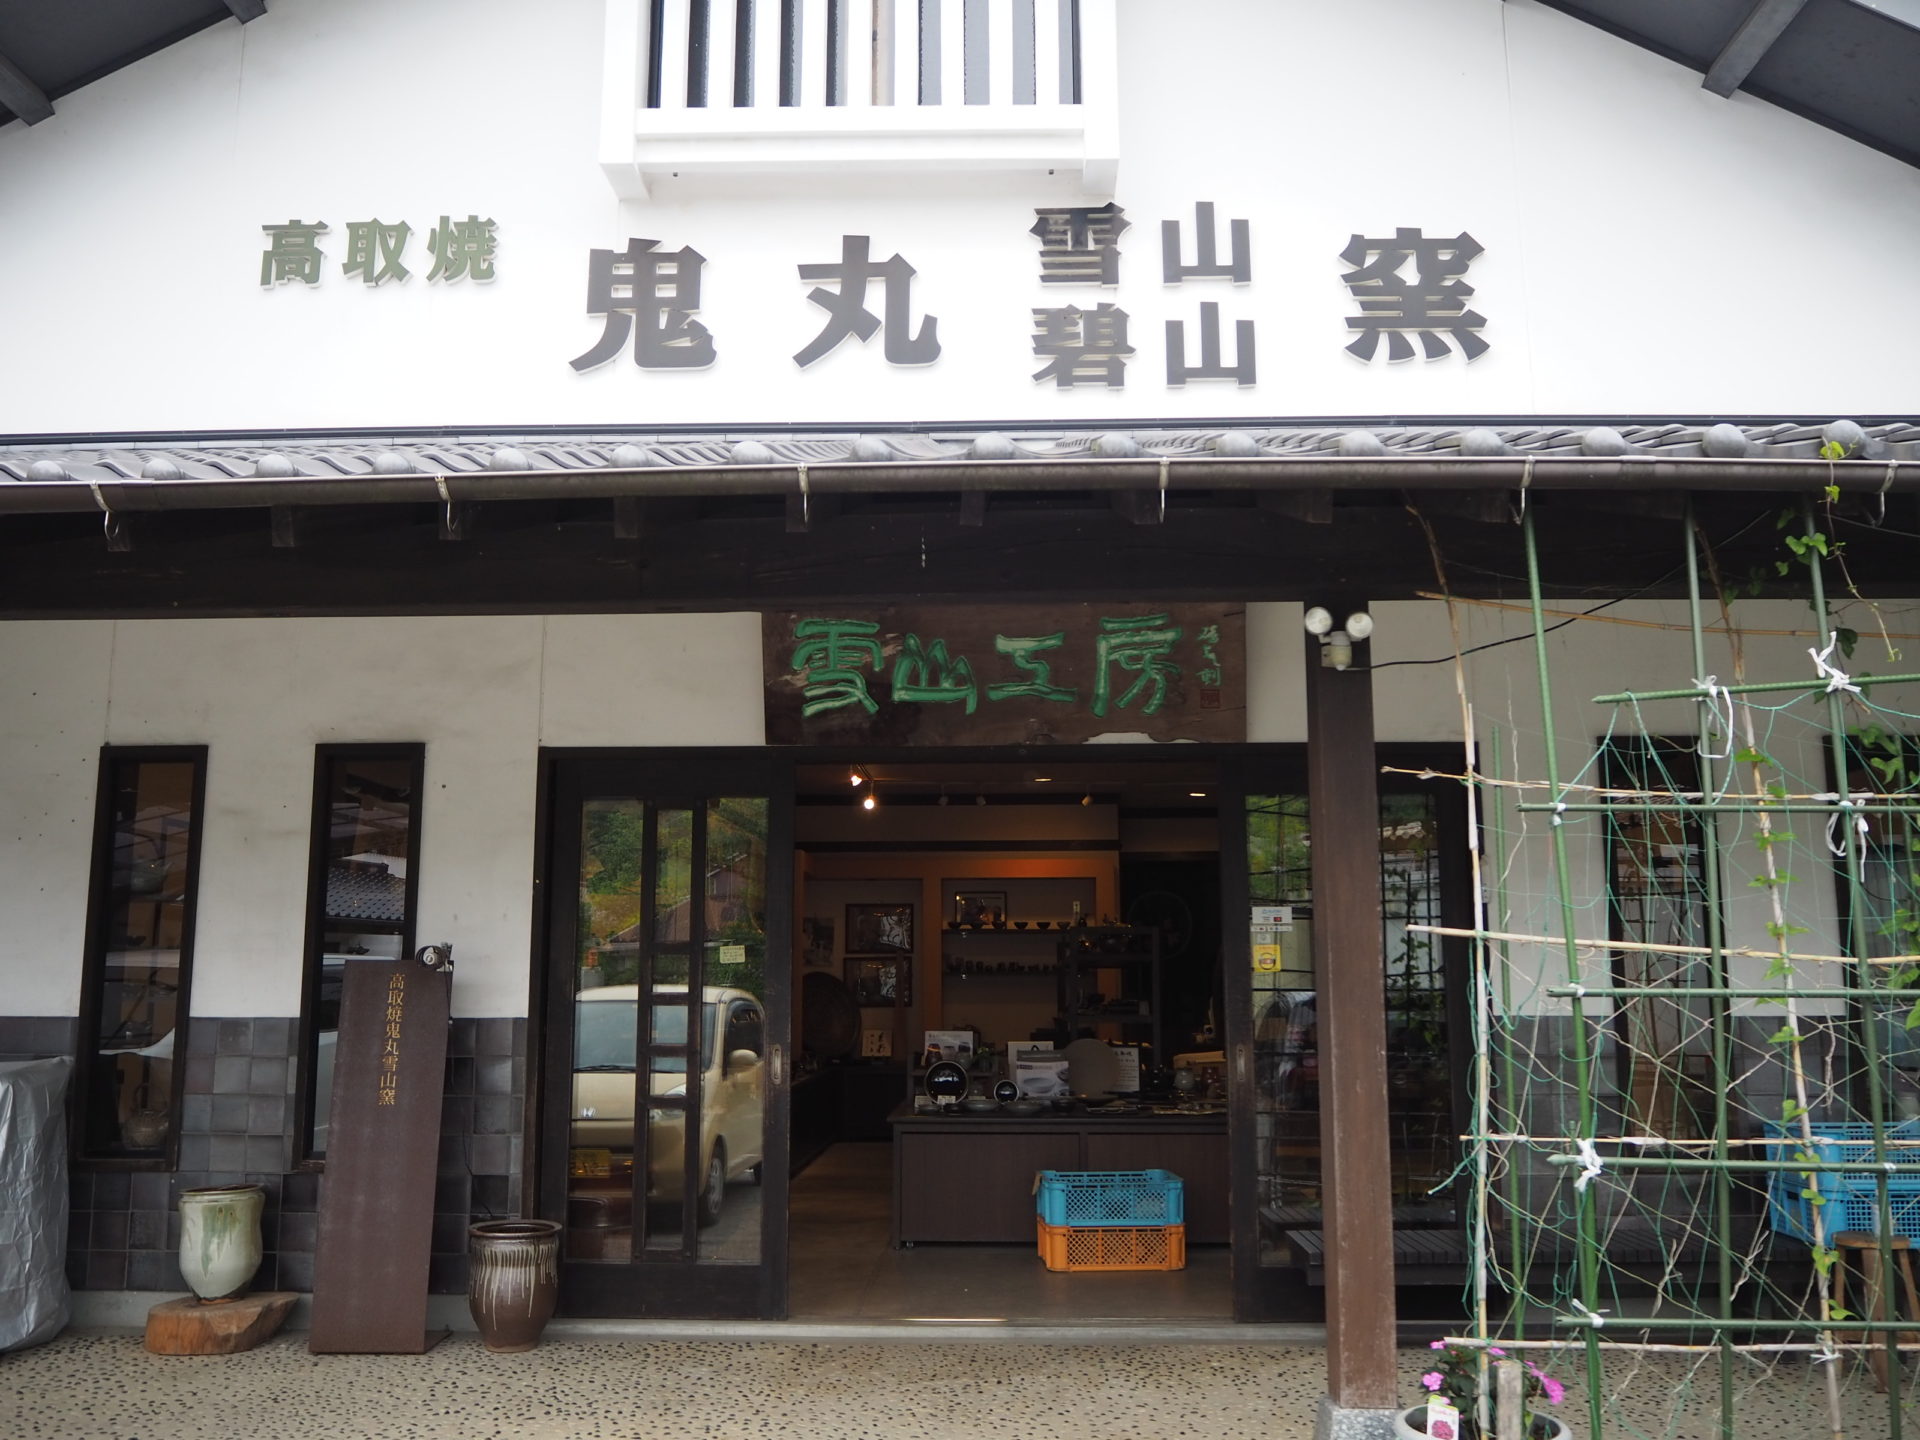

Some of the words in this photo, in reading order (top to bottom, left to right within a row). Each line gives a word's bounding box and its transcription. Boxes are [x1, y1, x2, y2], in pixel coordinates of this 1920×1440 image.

[260, 215, 498, 287] 高取焼
[1028, 201, 1252, 287] 雪山
[568, 234, 942, 373] 鬼丸
[1339, 226, 1491, 364] 窯
[1030, 302, 1257, 389] 碧山
[791, 614, 1183, 718] 雪山工房
